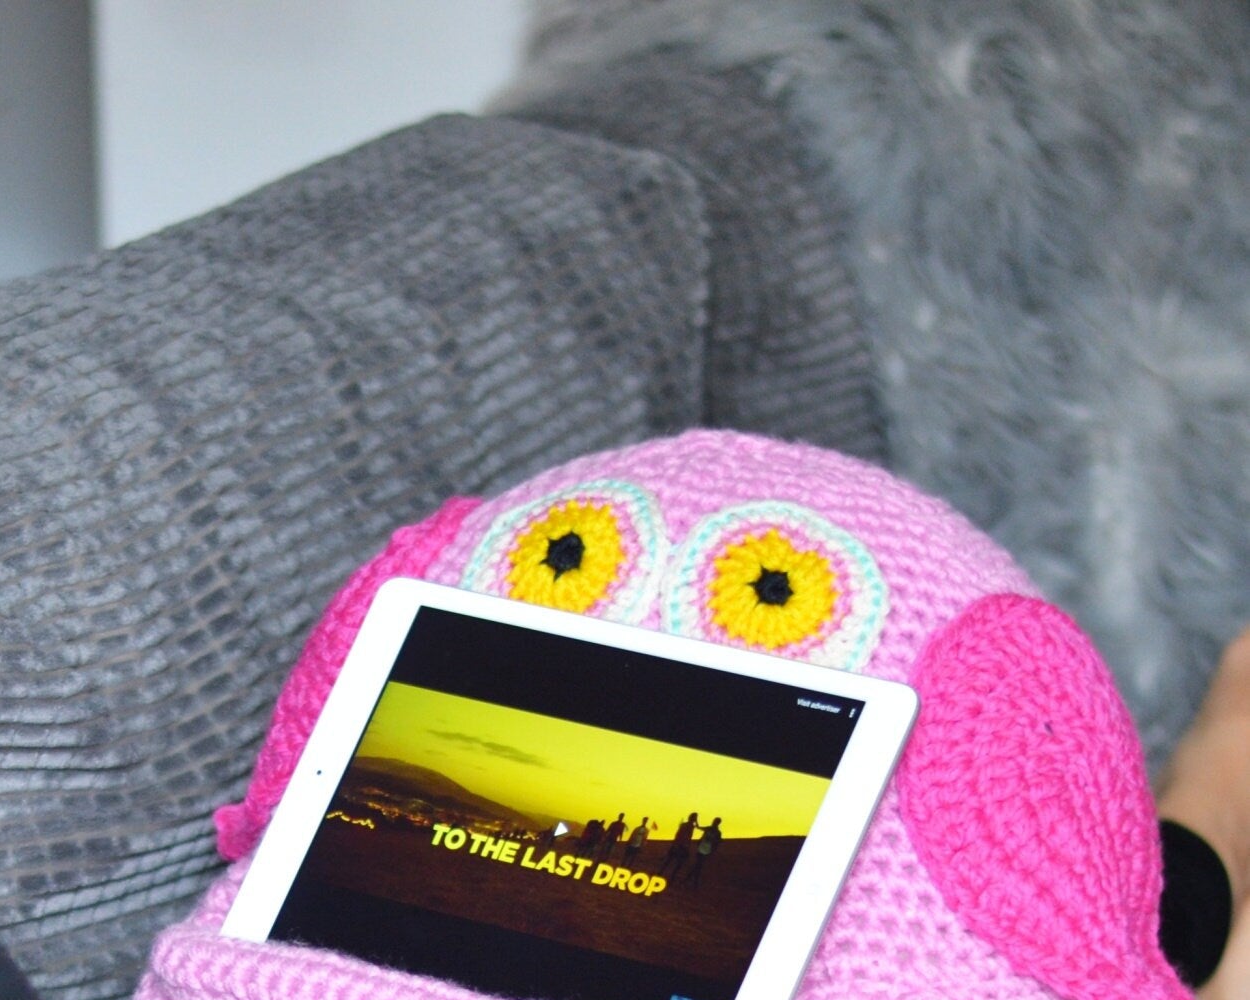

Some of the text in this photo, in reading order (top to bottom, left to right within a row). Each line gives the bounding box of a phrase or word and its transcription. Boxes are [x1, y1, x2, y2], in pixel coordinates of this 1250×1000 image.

[431, 823, 667, 897] TO THE LAST DROP
